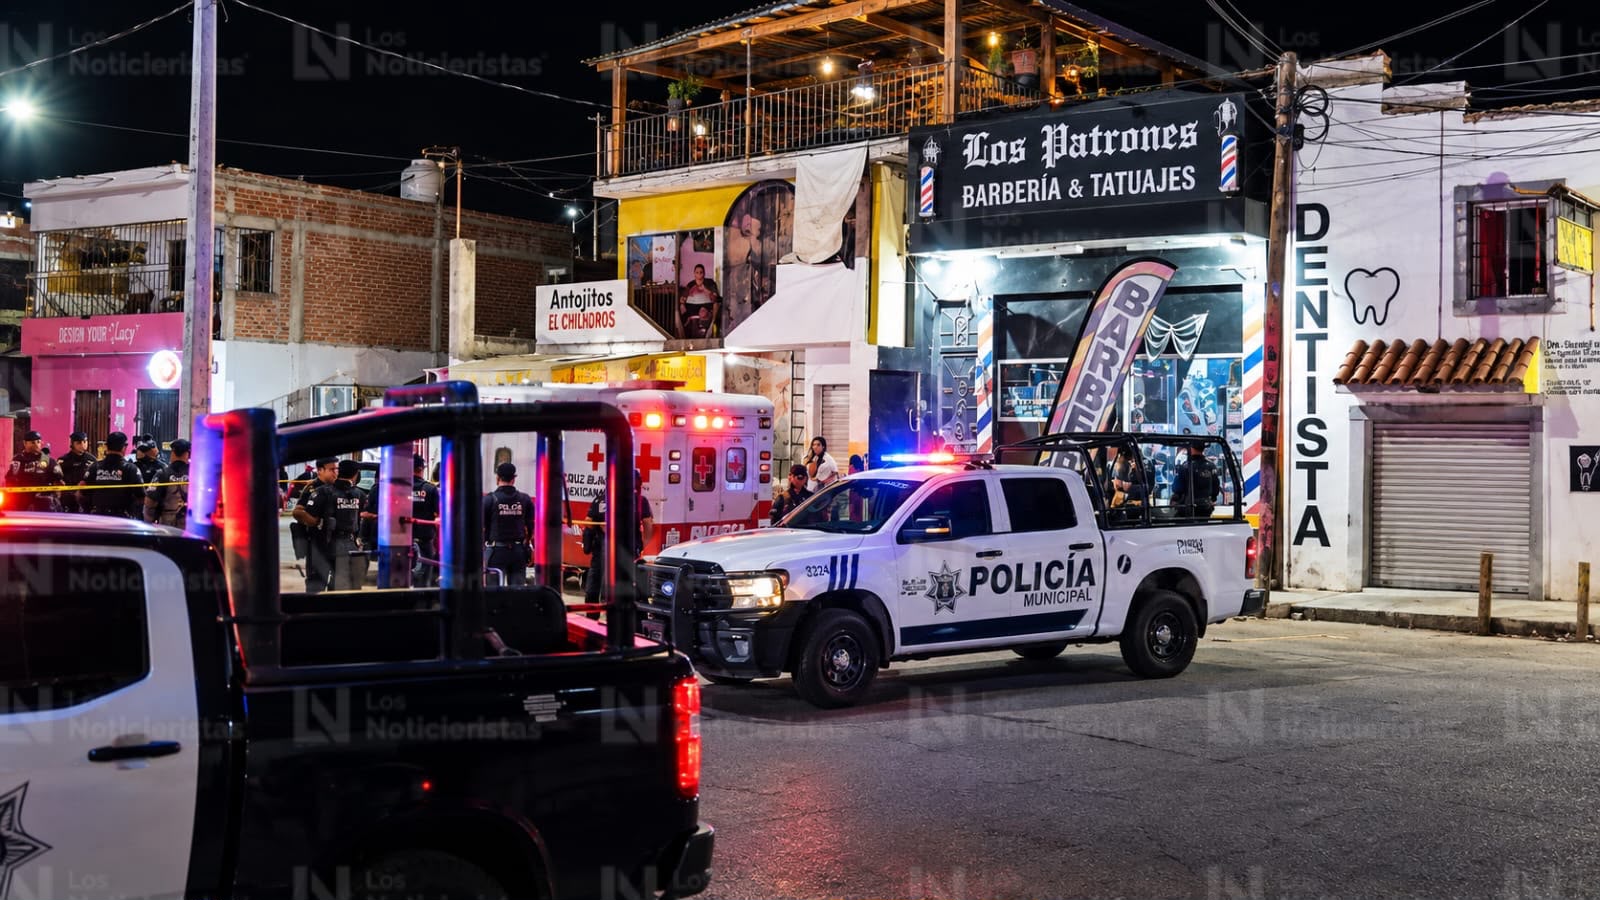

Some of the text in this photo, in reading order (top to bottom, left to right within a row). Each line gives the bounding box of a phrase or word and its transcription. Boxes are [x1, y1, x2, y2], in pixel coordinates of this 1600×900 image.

[962, 119, 1199, 170] Los Patrones
[962, 165, 1196, 208] BARBERÍA & TATUAJES
[550, 287, 613, 312] Antojitos
[59, 327, 85, 343] DESIGN
[88, 326, 107, 342] YOUR
[549, 314, 559, 330] EL
[1293, 203, 1331, 547] DENTISTA
[969, 553, 1096, 597] POLICÍA
[1023, 587, 1093, 607] MUNICIPAL
